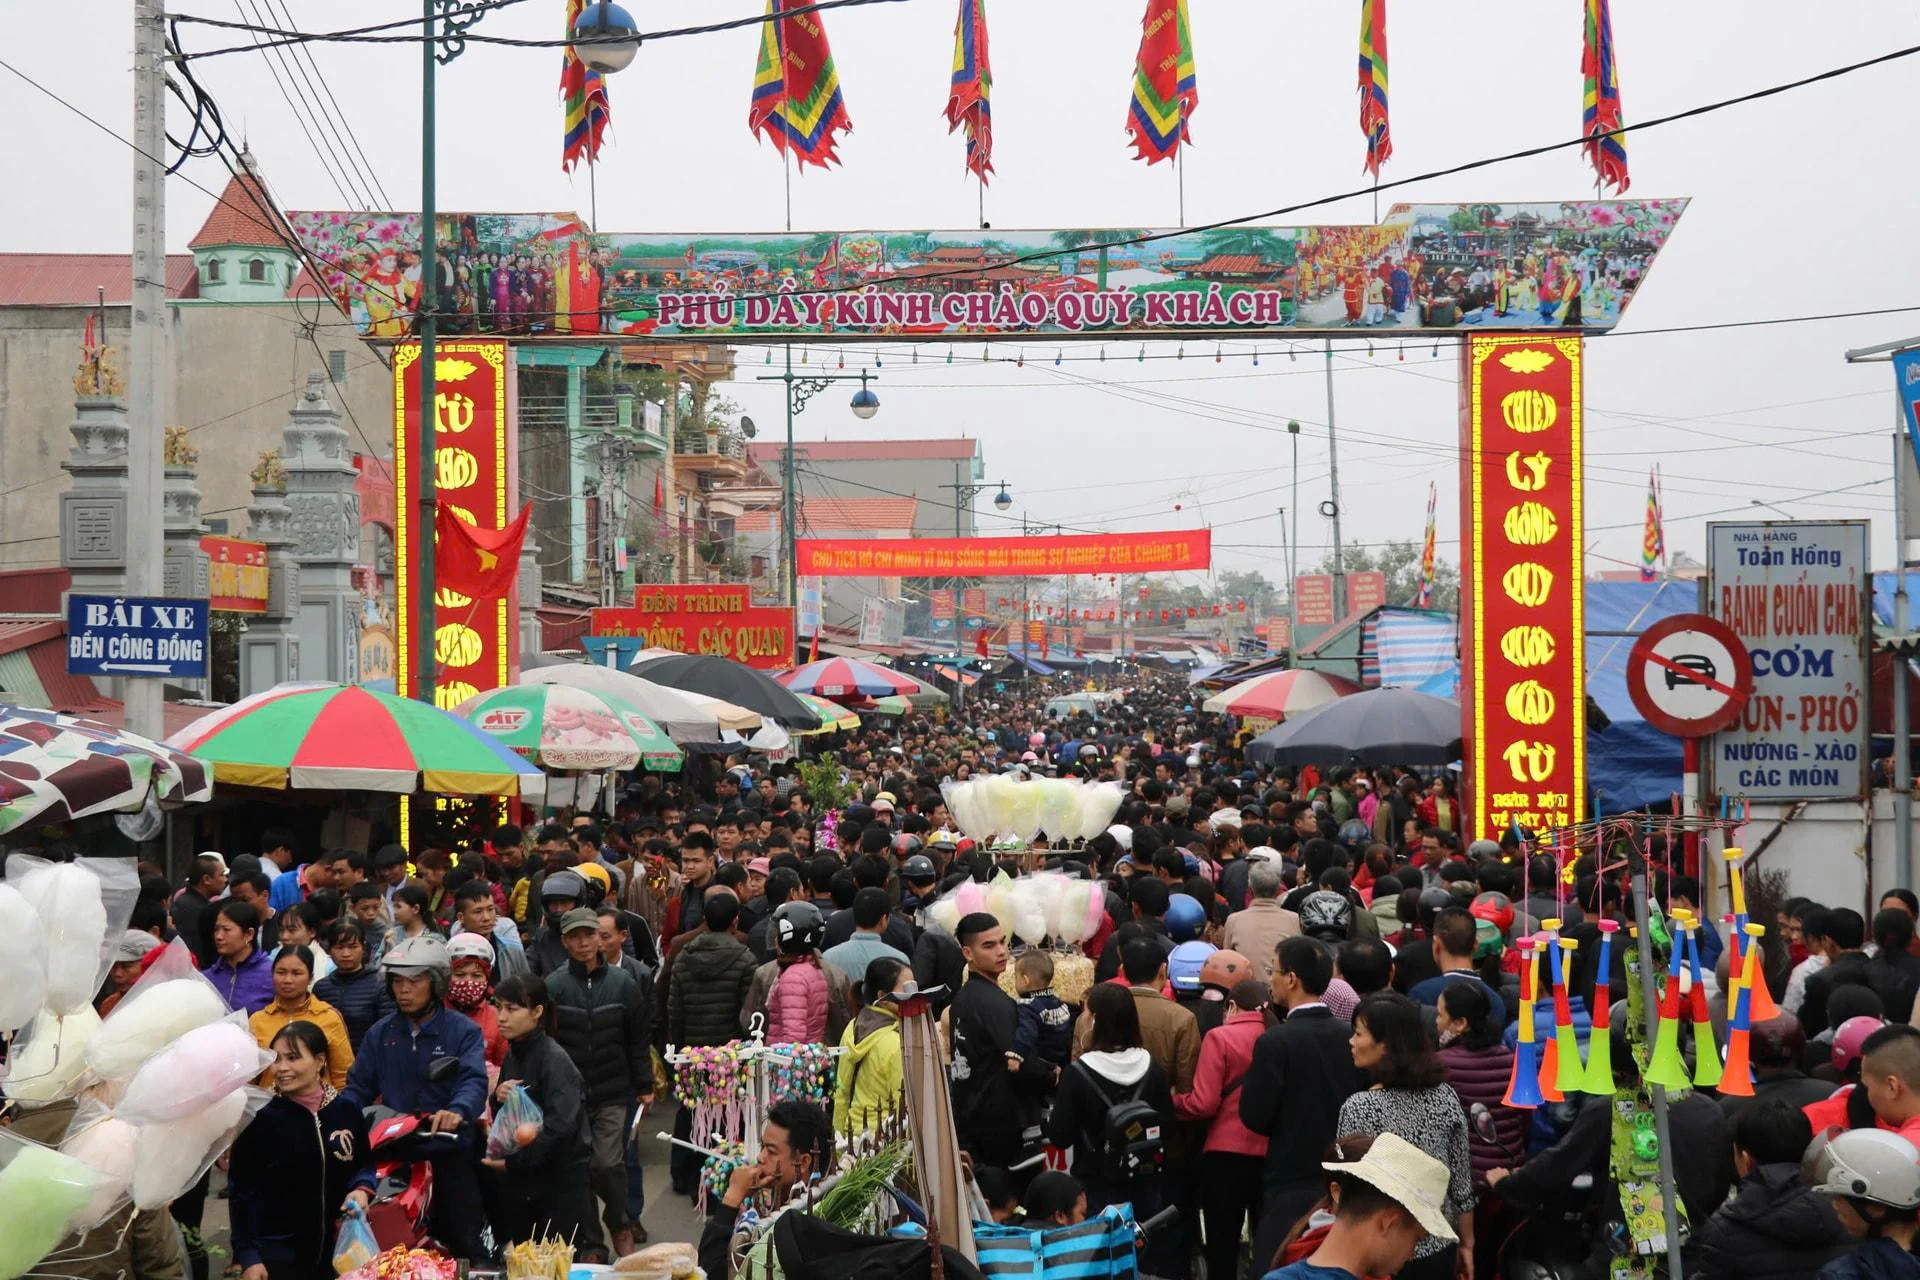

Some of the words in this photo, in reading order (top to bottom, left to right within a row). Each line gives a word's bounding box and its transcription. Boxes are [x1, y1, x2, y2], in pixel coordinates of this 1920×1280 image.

[658, 282, 735, 325] PHỦ
[745, 279, 825, 325] DẦY
[835, 286, 932, 325] KÍNH
[942, 285, 1047, 325] CHÀO
[1056, 284, 1137, 330] QUÝ
[1145, 282, 1281, 325] KHÁCH
[1501, 389, 1557, 433] THIÊN
[435, 447, 479, 490] HỜI
[1505, 451, 1552, 491] LÝ
[1734, 530, 1759, 542] NHÀ
[1763, 530, 1798, 542] HÀNG
[812, 544, 833, 568] CHỦ
[835, 550, 856, 571] TỊCH
[859, 545, 873, 568] HỒ
[875, 547, 892, 568] CHÍ
[895, 551, 921, 568] MINH
[957, 545, 985, 568] SỐNG
[1011, 549, 1045, 566] TRONG
[1049, 545, 1065, 570] SỰ
[1067, 542, 1106, 569] NGHIỆP
[1110, 539, 1131, 564] CỦA
[1135, 540, 1172, 563] CHÚNG
[1175, 543, 1190, 561] TA
[1791, 543, 1842, 568] Hồng
[85, 598, 144, 628] BÃI
[151, 606, 194, 629] XE
[642, 587, 678, 613] ĐỀN
[684, 588, 743, 613] TRÌNH
[1722, 575, 1767, 637] BÁNH
[1773, 569, 1818, 636] CUỐN
[1824, 566, 1858, 636] CHẢ
[108, 632, 154, 660] CÔNG
[157, 632, 203, 662] ĐỒNG
[698, 620, 733, 655] CÁC
[736, 626, 786, 663] QUAN
[1749, 643, 1834, 678] CƠM
[1724, 737, 1798, 761] NƯỚNG
[1814, 739, 1857, 761] XÀO
[1739, 765, 1782, 787] CÁC
[1788, 764, 1839, 786] MÓN
